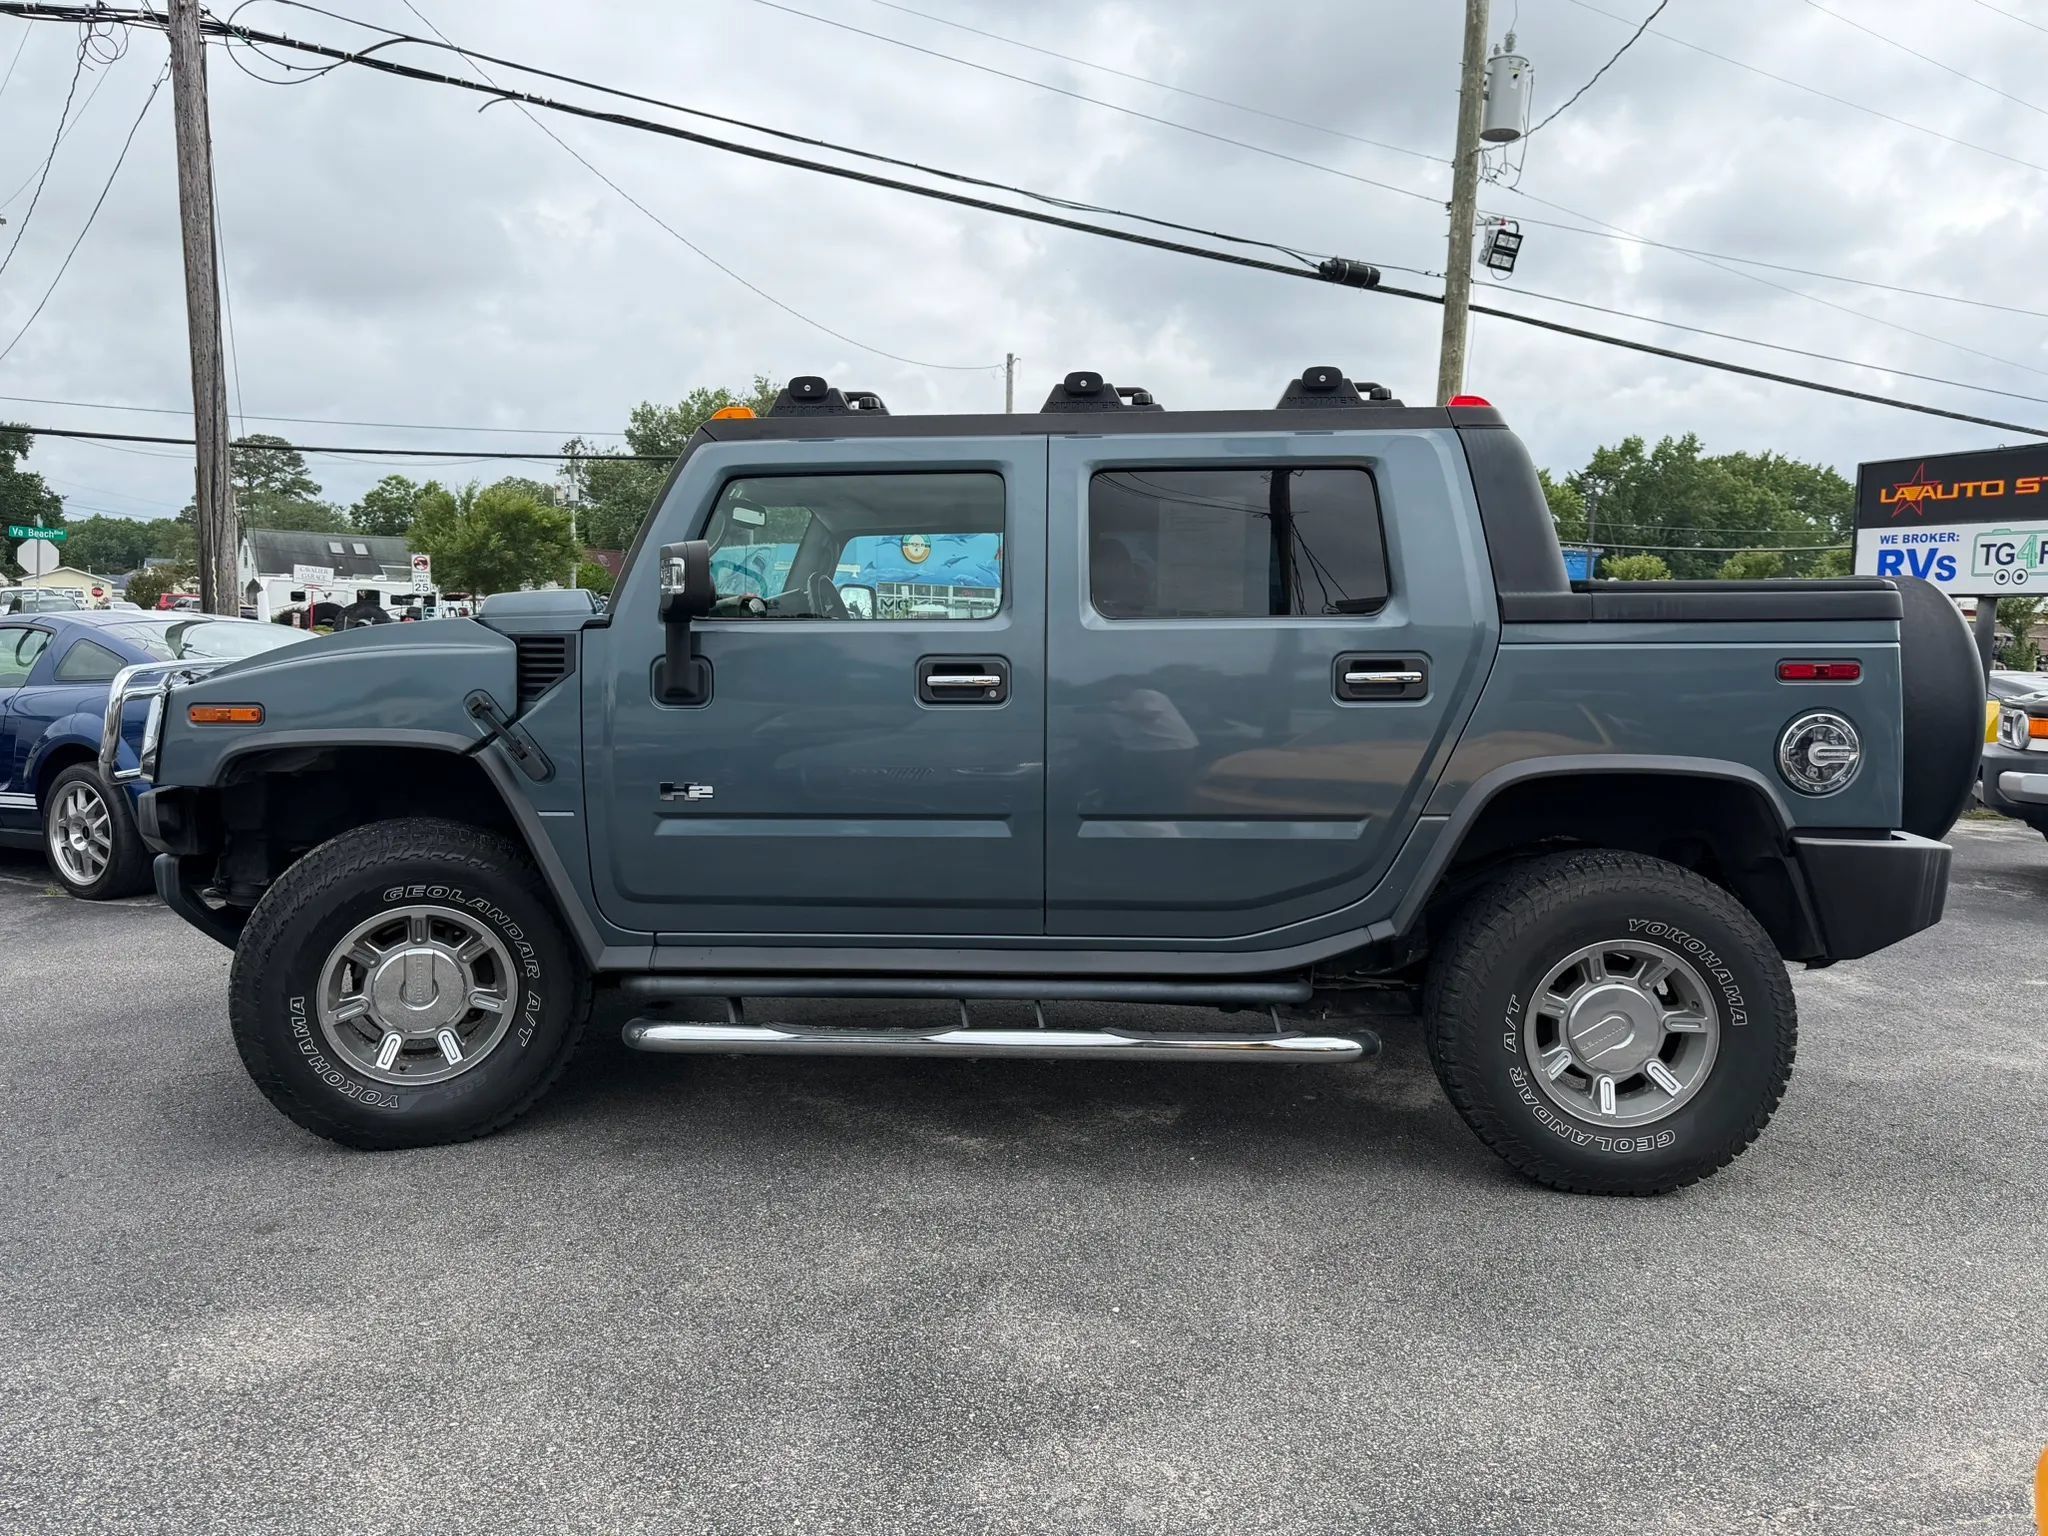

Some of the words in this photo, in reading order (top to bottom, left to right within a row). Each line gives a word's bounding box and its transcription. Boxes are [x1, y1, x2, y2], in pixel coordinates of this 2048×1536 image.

[1917, 479, 2005, 501] AUTO
[12, 527, 24, 536] Va
[28, 528, 54, 538] Beach
[1879, 534, 1898, 545] WE
[1902, 533, 1960, 544] BROKER:
[1877, 547, 1957, 582] RVs
[415, 583, 429, 592] 25
[659, 782, 714, 801] H2
[382, 884, 542, 980] GEOLANDAR
[521, 990, 543, 1048] A/T
[1628, 917, 1748, 1027] YOKOHAMA
[1502, 993, 1520, 1054] A/T
[288, 995, 400, 1110] YOKOHAMA
[1510, 1066, 1676, 1154] GEOLANDAR
